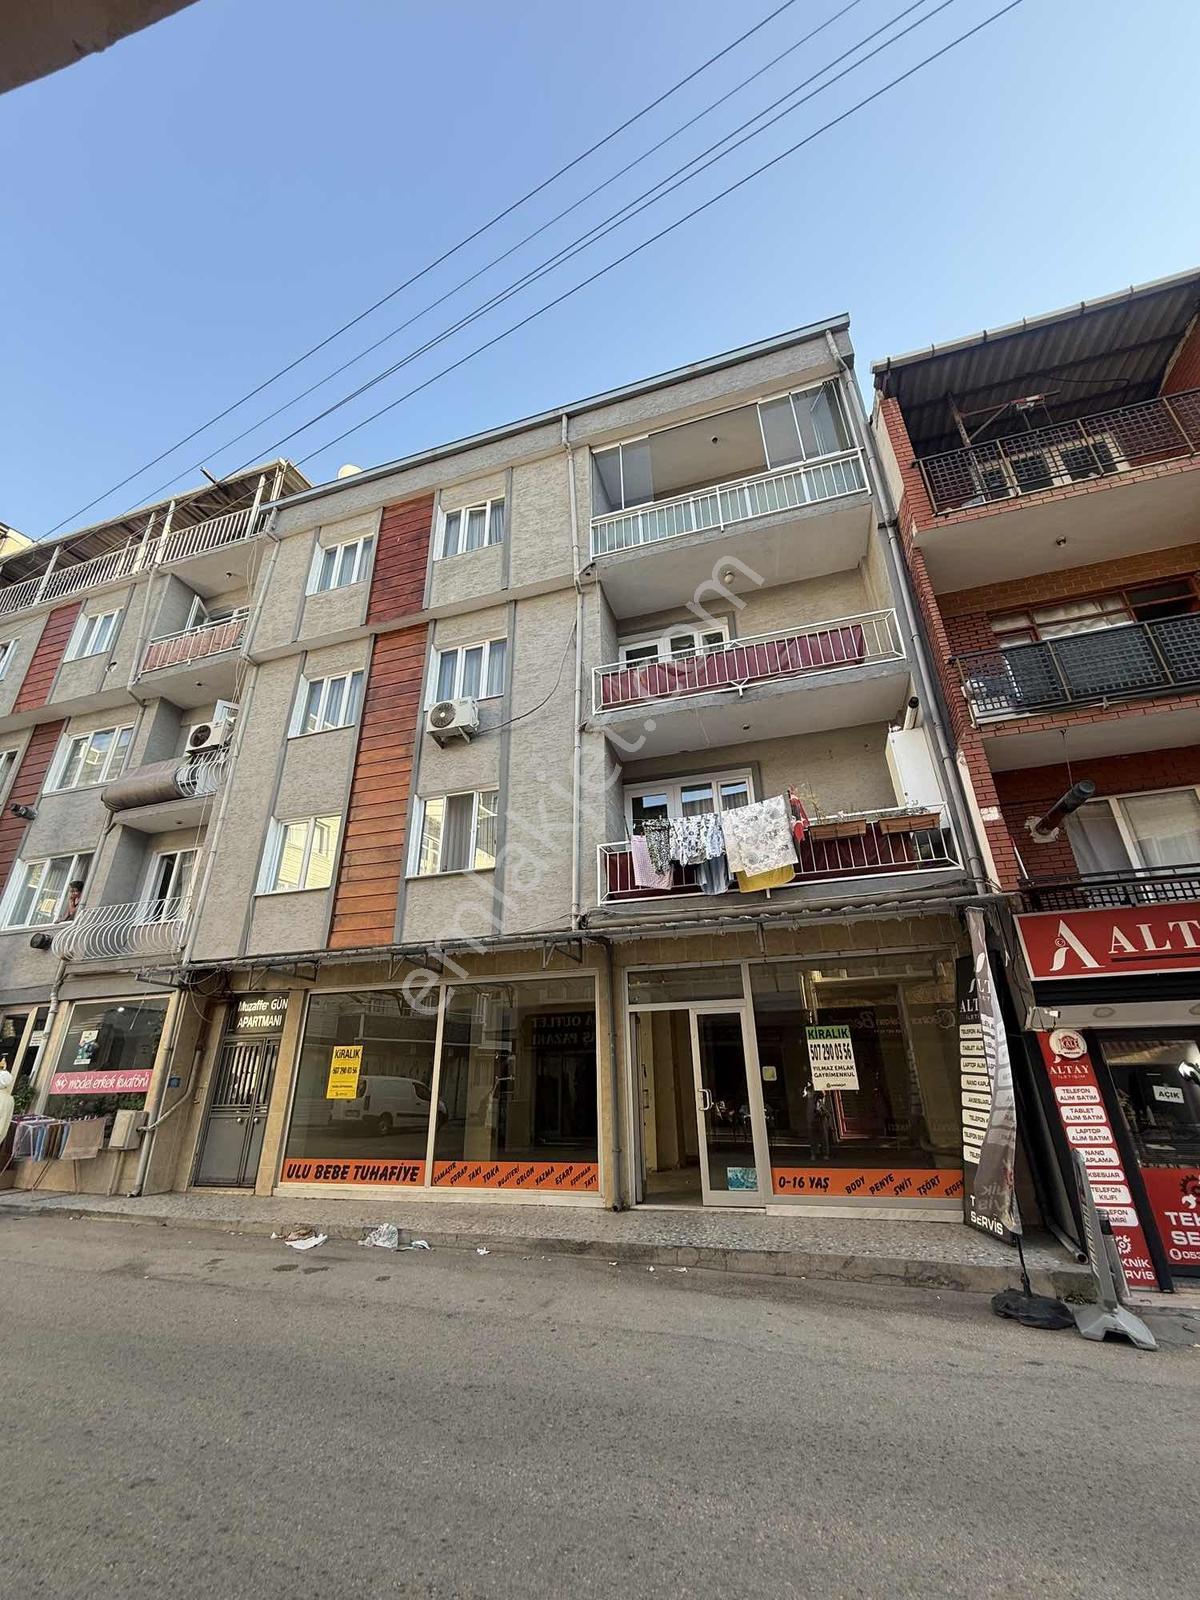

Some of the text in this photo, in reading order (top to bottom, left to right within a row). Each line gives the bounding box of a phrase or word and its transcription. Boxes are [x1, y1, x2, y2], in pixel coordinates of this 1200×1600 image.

[238, 996, 289, 1012] Muzaffer GÜN
[237, 1014, 283, 1029] APARTMANI
[807, 1026, 849, 1040] KİRALIK
[335, 1048, 361, 1059] KİRALIK
[810, 1042, 852, 1060] 507 290 03 56
[1049, 1065, 1089, 1074] ALTAY
[1158, 1091, 1180, 1099] AÇIK
[287, 1162, 421, 1182] ULU BEBE TUHAFİYE
[468, 1166, 482, 1182] TAKI
[482, 1165, 500, 1183] TOKA
[535, 1166, 555, 1186] YAZMA
[778, 1176, 830, 1193] 0-16 YAŞ
[844, 1175, 866, 1195] BODY
[869, 1173, 895, 1195] PENYE
[893, 1176, 913, 1196] SWİT
[970, 1211, 1004, 1235] SERVİS
[1121, 1256, 1151, 1268] KNİK
[1124, 1268, 1155, 1280] RVİS
